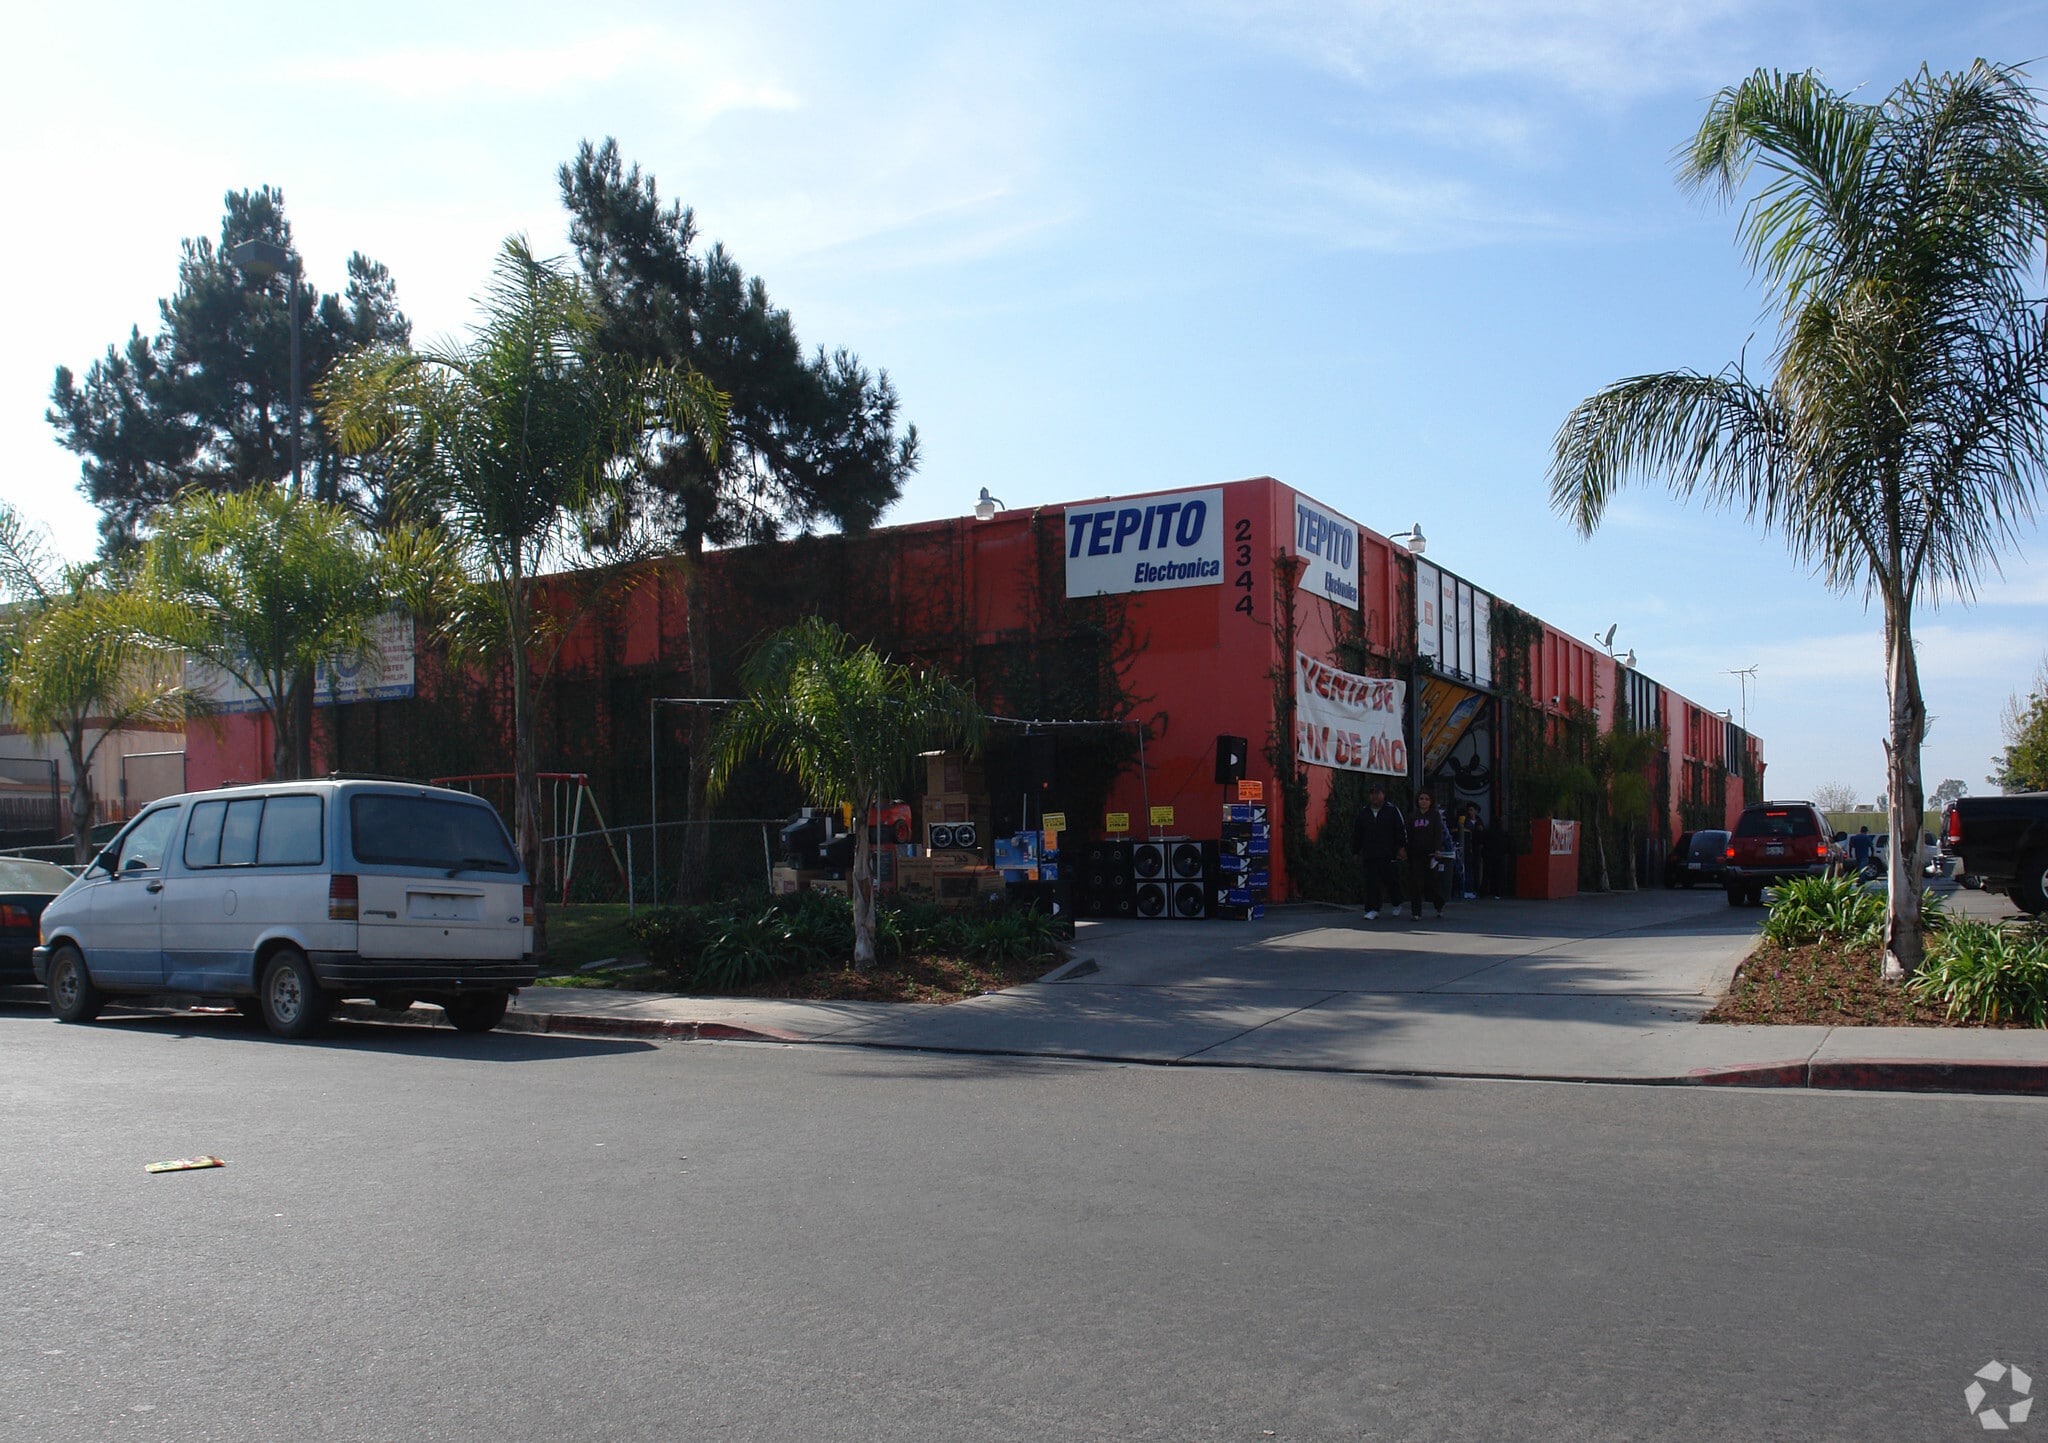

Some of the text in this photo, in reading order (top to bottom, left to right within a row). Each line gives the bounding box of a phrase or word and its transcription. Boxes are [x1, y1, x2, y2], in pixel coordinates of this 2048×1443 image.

[1068, 500, 1207, 558] TEPITO
[1297, 504, 1353, 570] TEPITO
[1134, 557, 1220, 583] Electronica
[1235, 519, 1254, 616] 2344
[1300, 656, 1395, 714] VENTA DE
[1296, 720, 1406, 773] FIN DE AÑO
